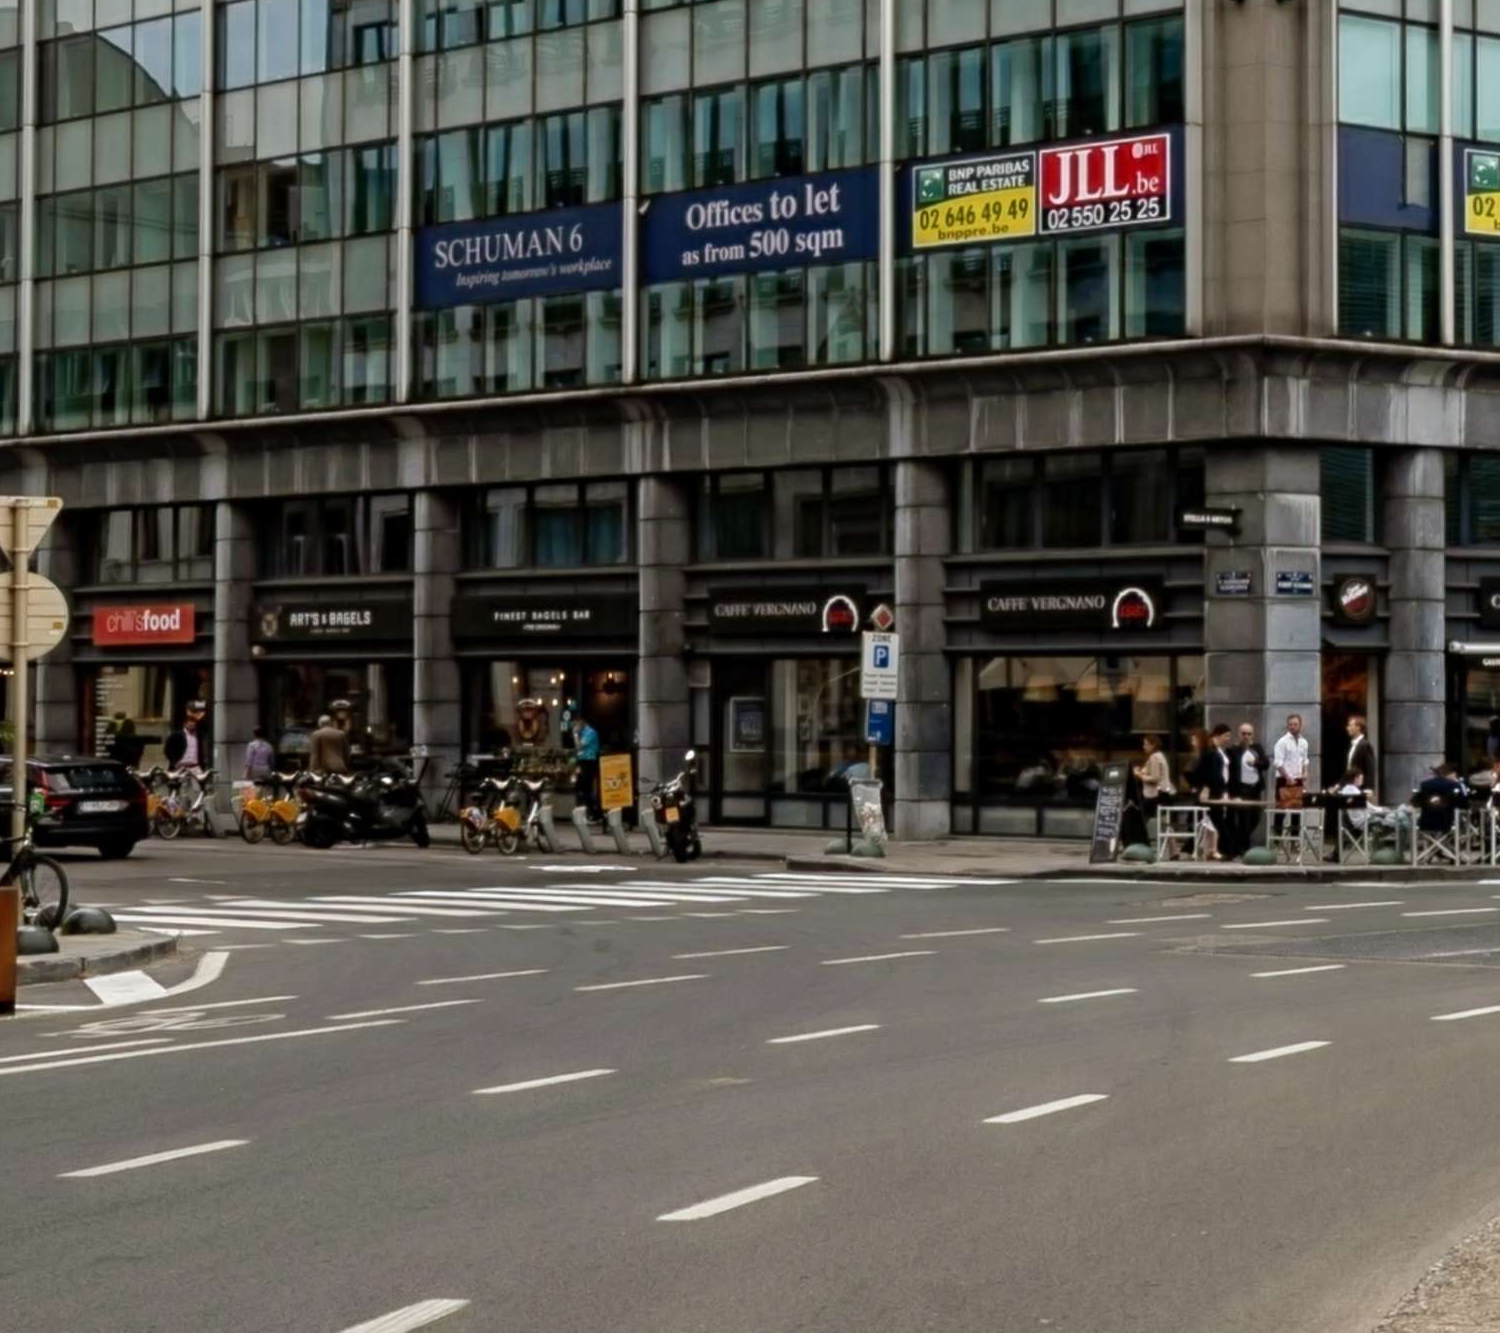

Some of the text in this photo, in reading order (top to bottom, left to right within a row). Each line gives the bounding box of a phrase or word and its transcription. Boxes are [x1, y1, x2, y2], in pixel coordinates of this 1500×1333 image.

[948, 159, 1030, 182] BNP PARIBAS
[948, 174, 1026, 196] REAL ESTATE
[685, 182, 841, 230] Offices to let
[920, 197, 1028, 230] 02 646 49 49
[1047, 196, 1160, 229] 02 550 25 25
[1472, 196, 1495, 218] 02
[938, 223, 1009, 240] bnppre.be
[434, 222, 583, 269] SCHUMAN 6
[682, 228, 843, 266] as from 500 sqm
[455, 257, 613, 289] Inspiring tomorrow's workplace
[753, 601, 817, 616] VERGNANO
[1031, 595, 1106, 611] VERGNANO
[329, 610, 372, 626] BAGELS
